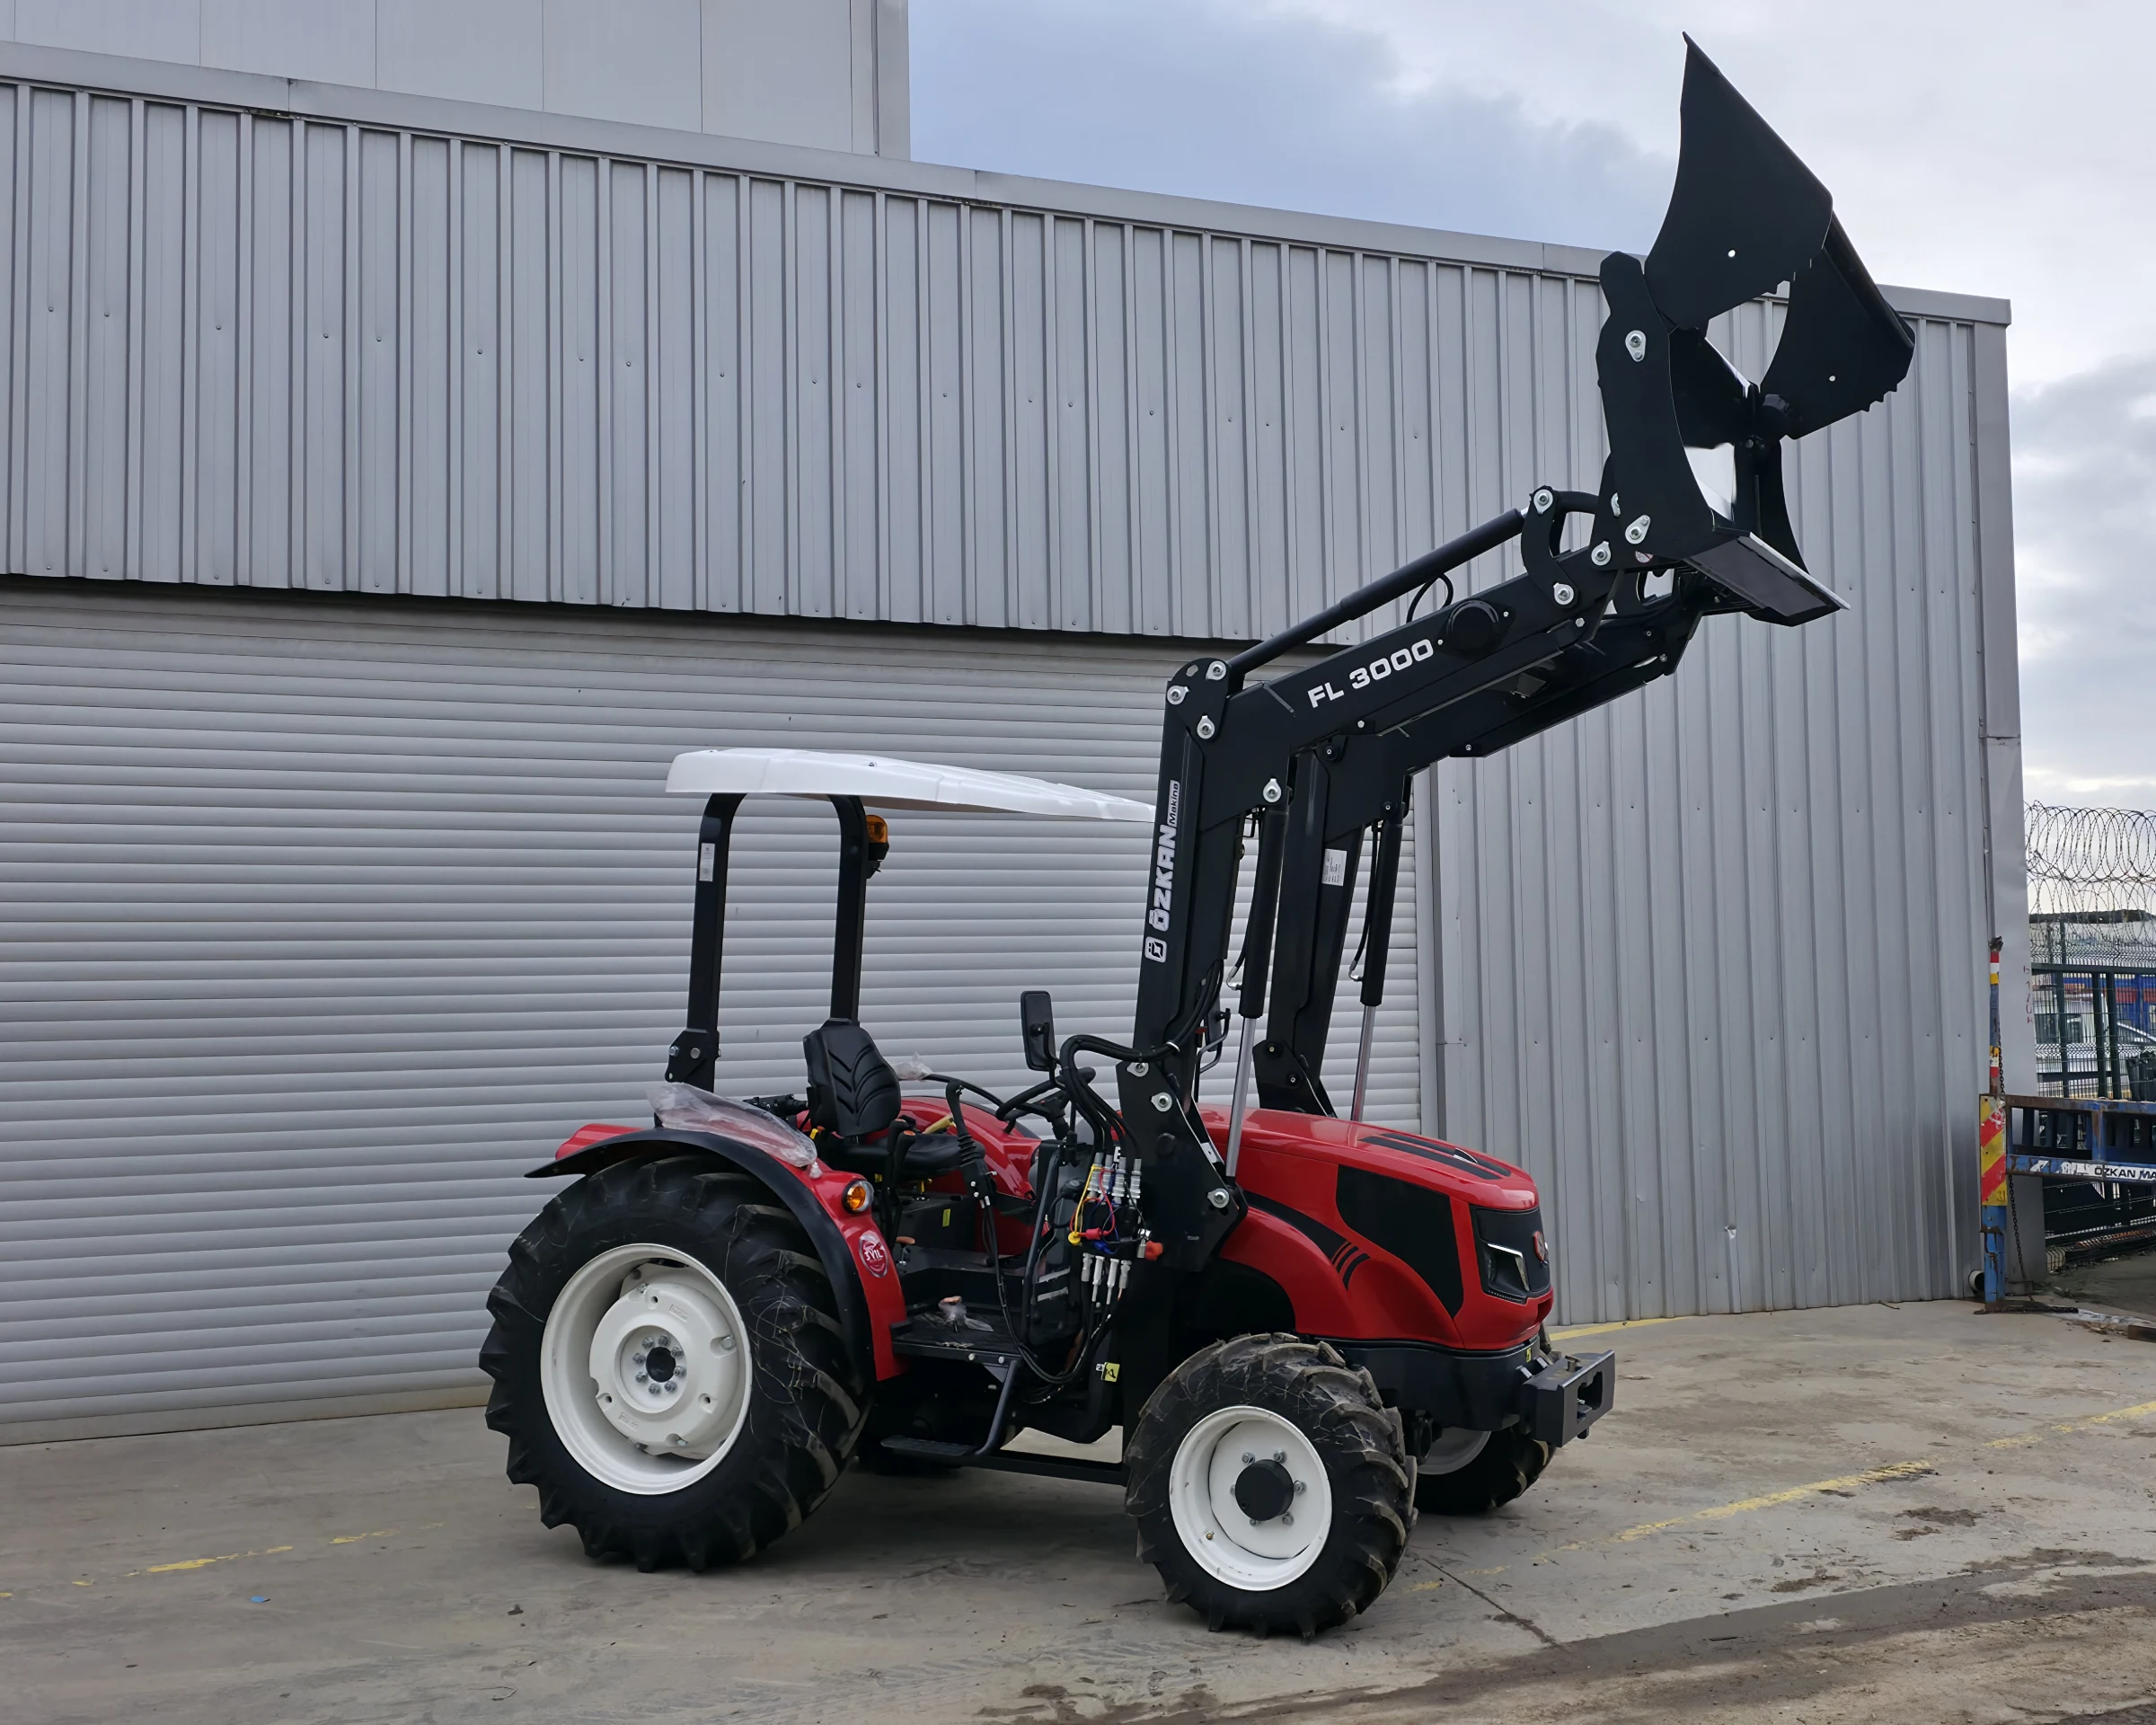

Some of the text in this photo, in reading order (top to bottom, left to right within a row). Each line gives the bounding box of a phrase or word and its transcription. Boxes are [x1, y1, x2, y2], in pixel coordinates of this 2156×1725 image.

[1307, 639, 1434, 708] FL 3000
[1149, 824, 1177, 932] ÖZKAN
[1169, 782, 1179, 825] Makina
[2095, 1165, 2136, 1178] ÖZKAN
